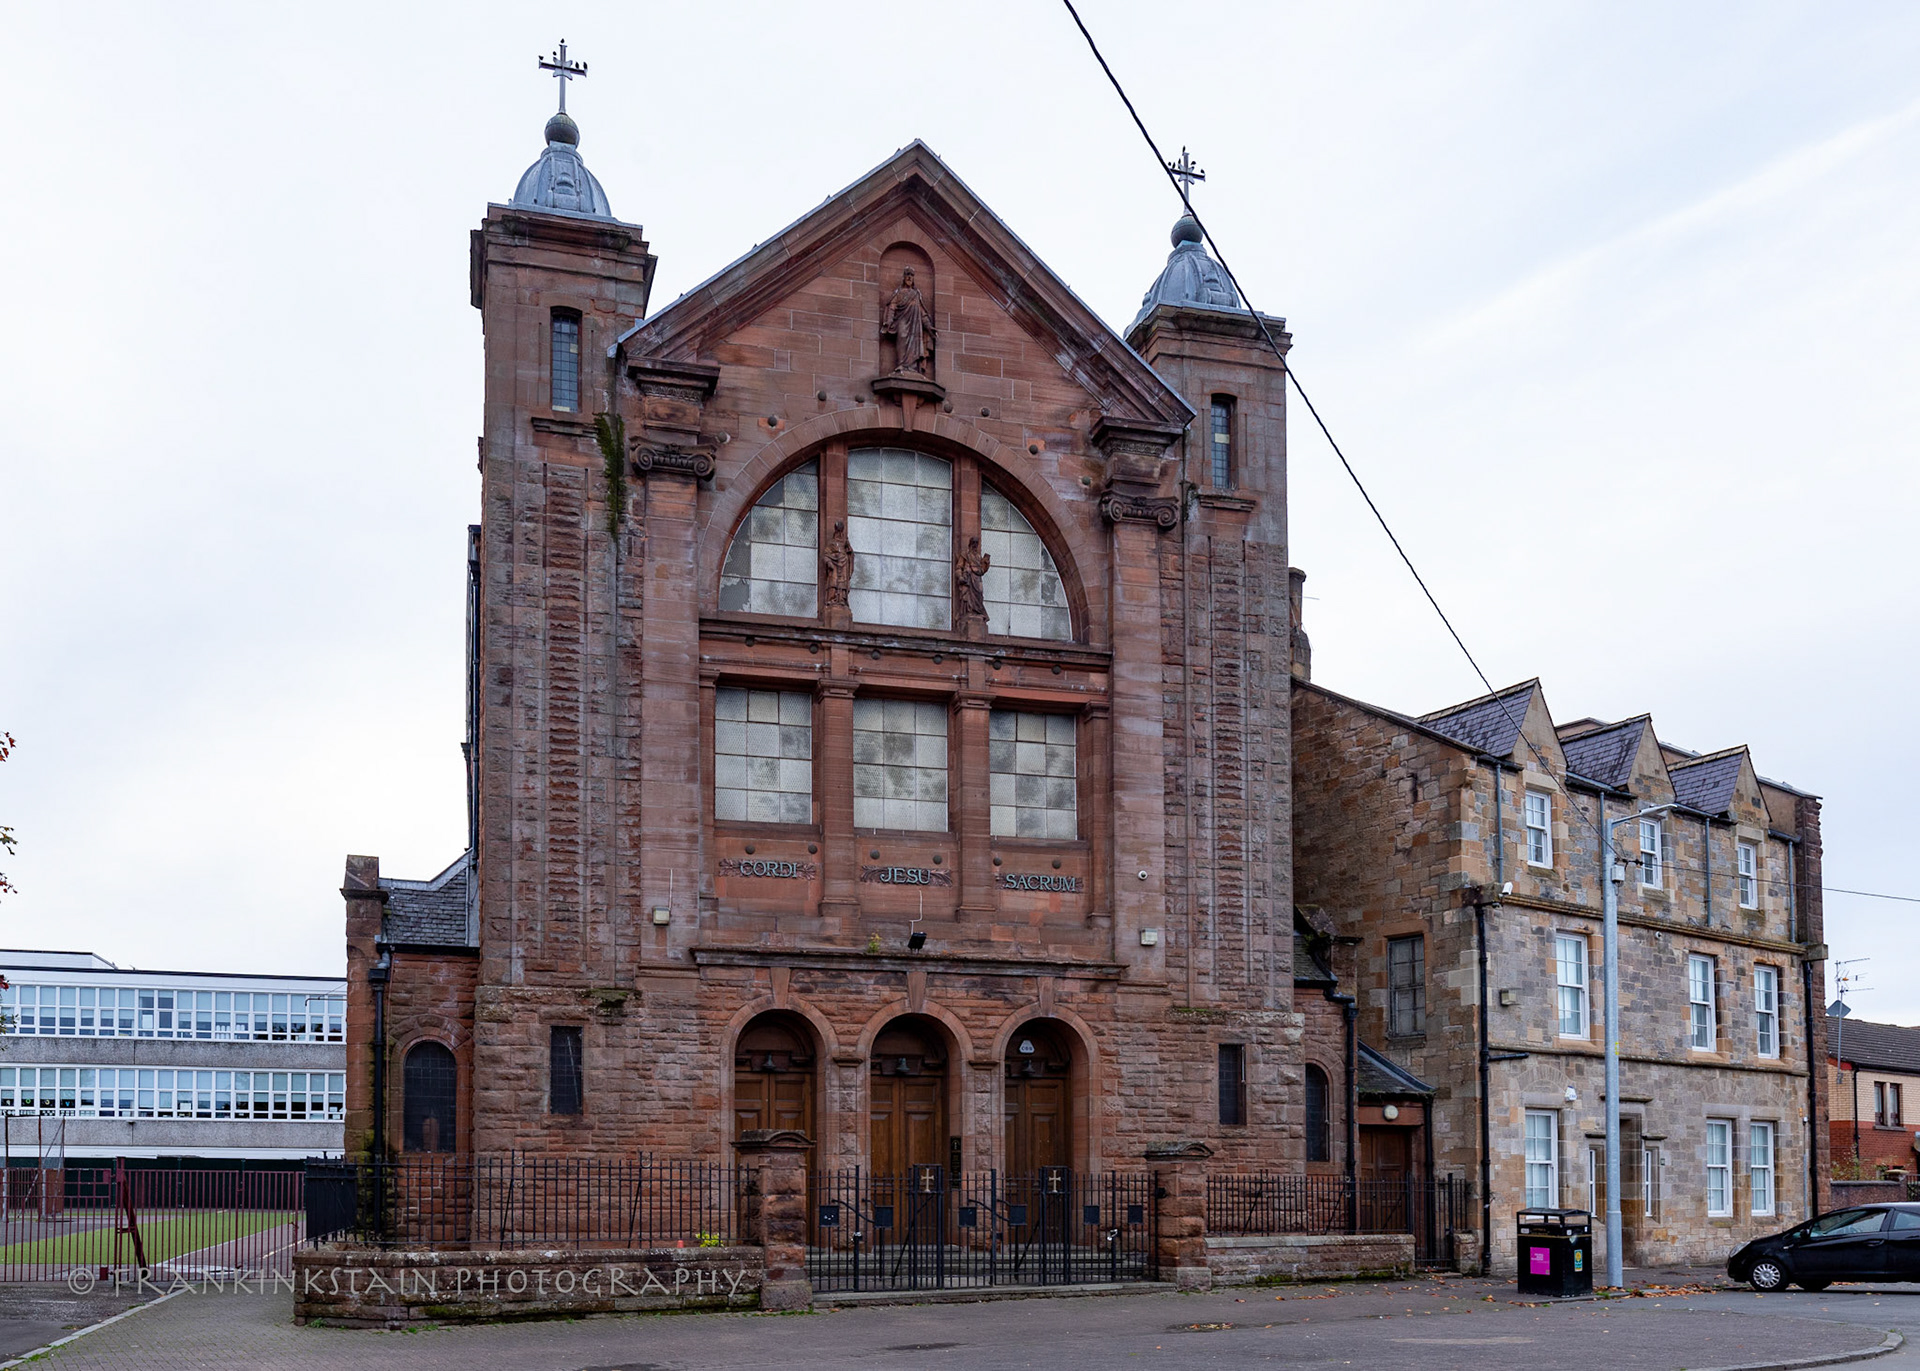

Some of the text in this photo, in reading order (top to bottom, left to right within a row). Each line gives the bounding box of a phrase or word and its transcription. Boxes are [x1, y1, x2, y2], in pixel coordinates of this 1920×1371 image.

[740, 860, 1077, 892] CORDI JESU SACRUM
